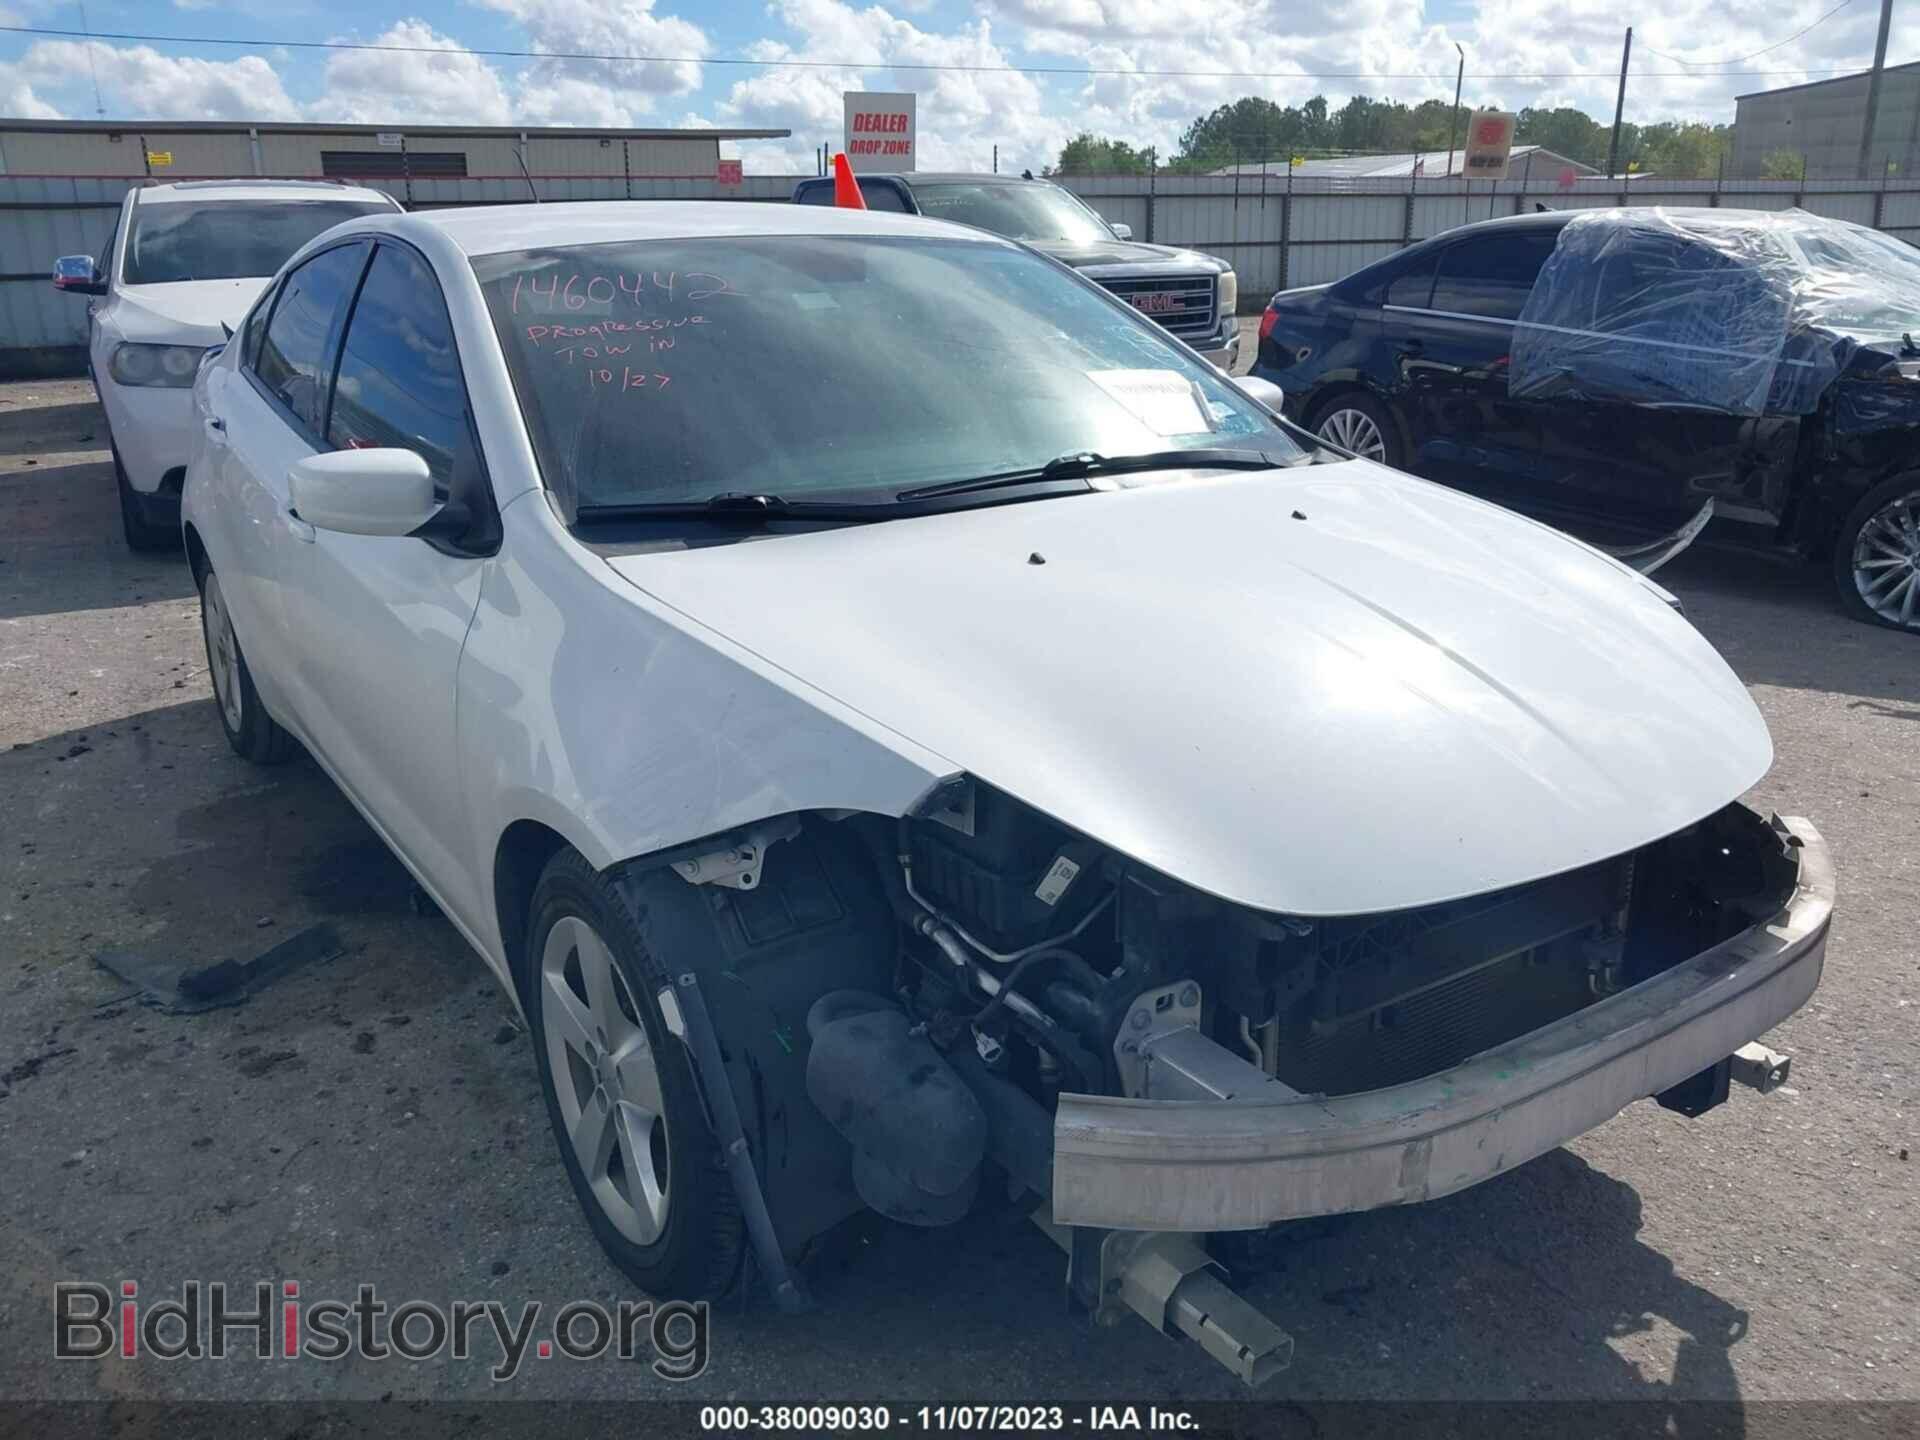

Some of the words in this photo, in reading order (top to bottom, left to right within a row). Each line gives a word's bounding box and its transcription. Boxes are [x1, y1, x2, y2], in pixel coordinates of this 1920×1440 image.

[853, 113, 908, 133] DEALER
[850, 140, 881, 154] DROP
[882, 140, 911, 155] ZONE
[512, 271, 751, 313] 1460442
[1132, 293, 1185, 312] GMC
[588, 367, 671, 393] 10/27
